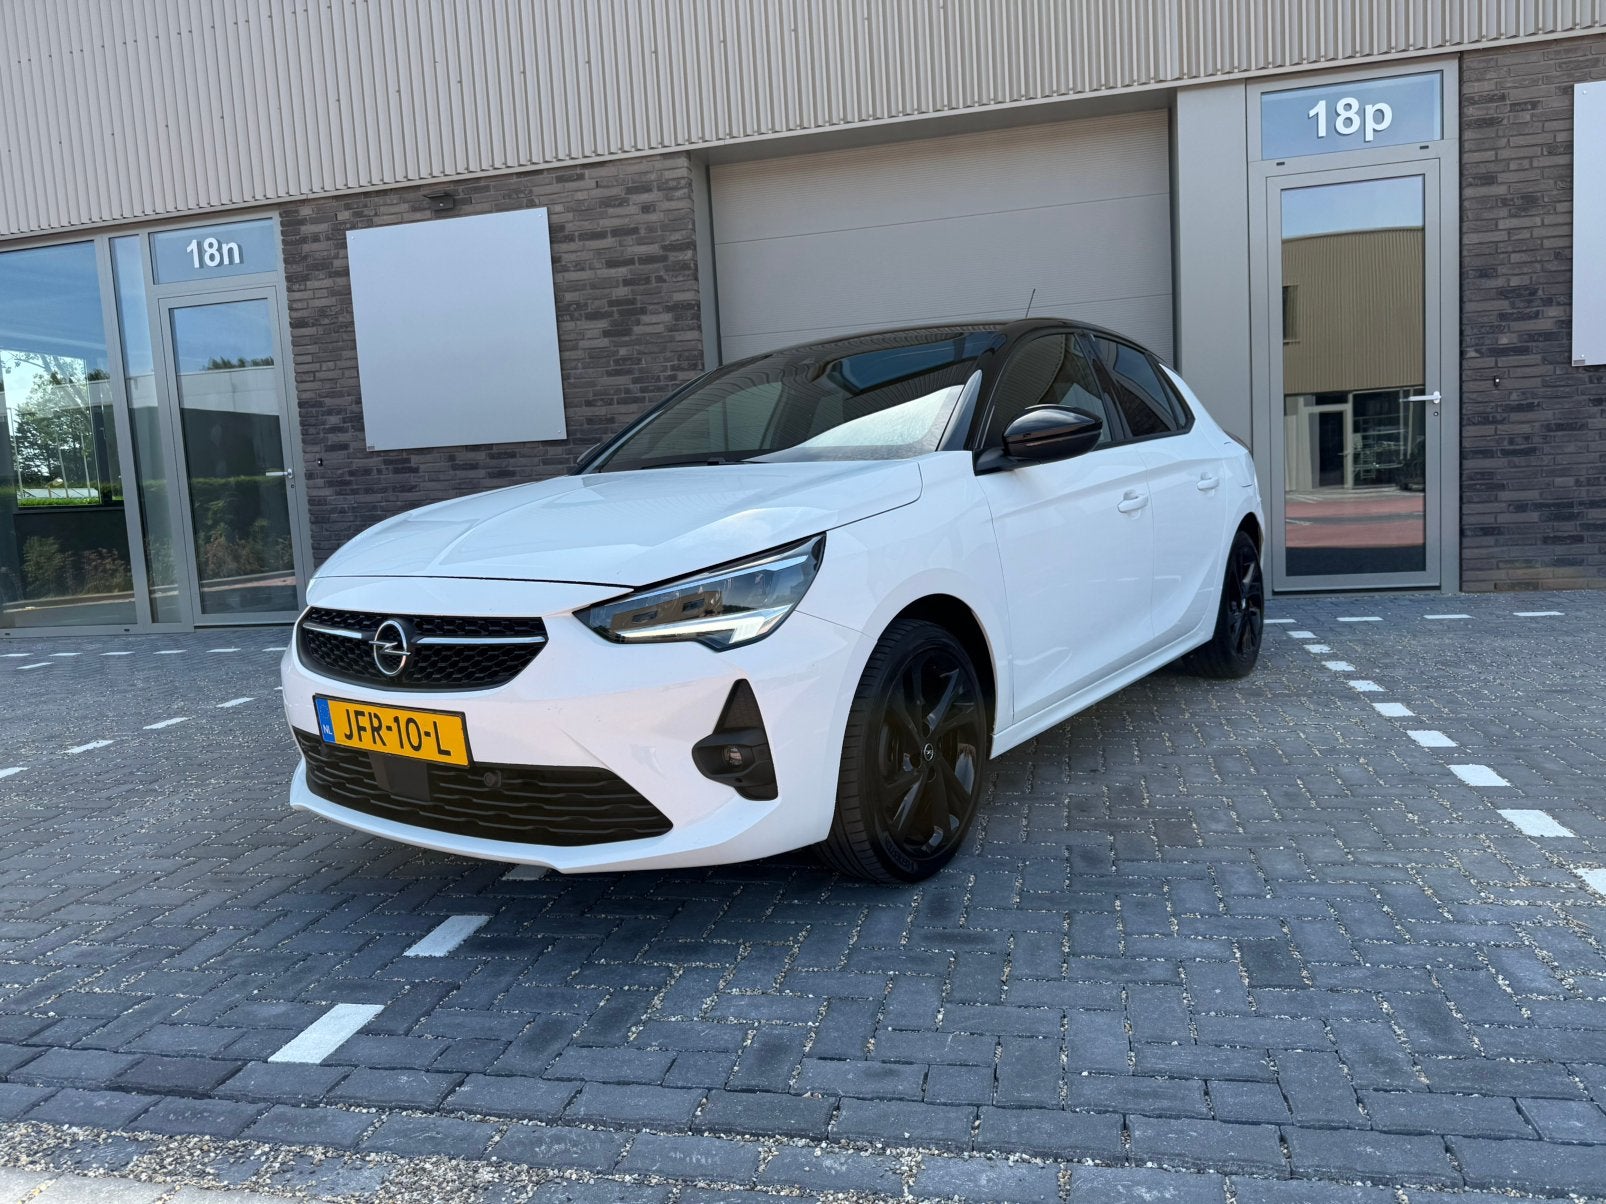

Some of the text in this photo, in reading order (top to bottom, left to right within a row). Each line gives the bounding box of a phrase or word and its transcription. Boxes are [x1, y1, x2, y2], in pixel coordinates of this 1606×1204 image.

[1308, 97, 1393, 142] 18p
[186, 237, 241, 268] 18n
[323, 724, 333, 735] NL
[344, 708, 451, 756] JFR-10-L
